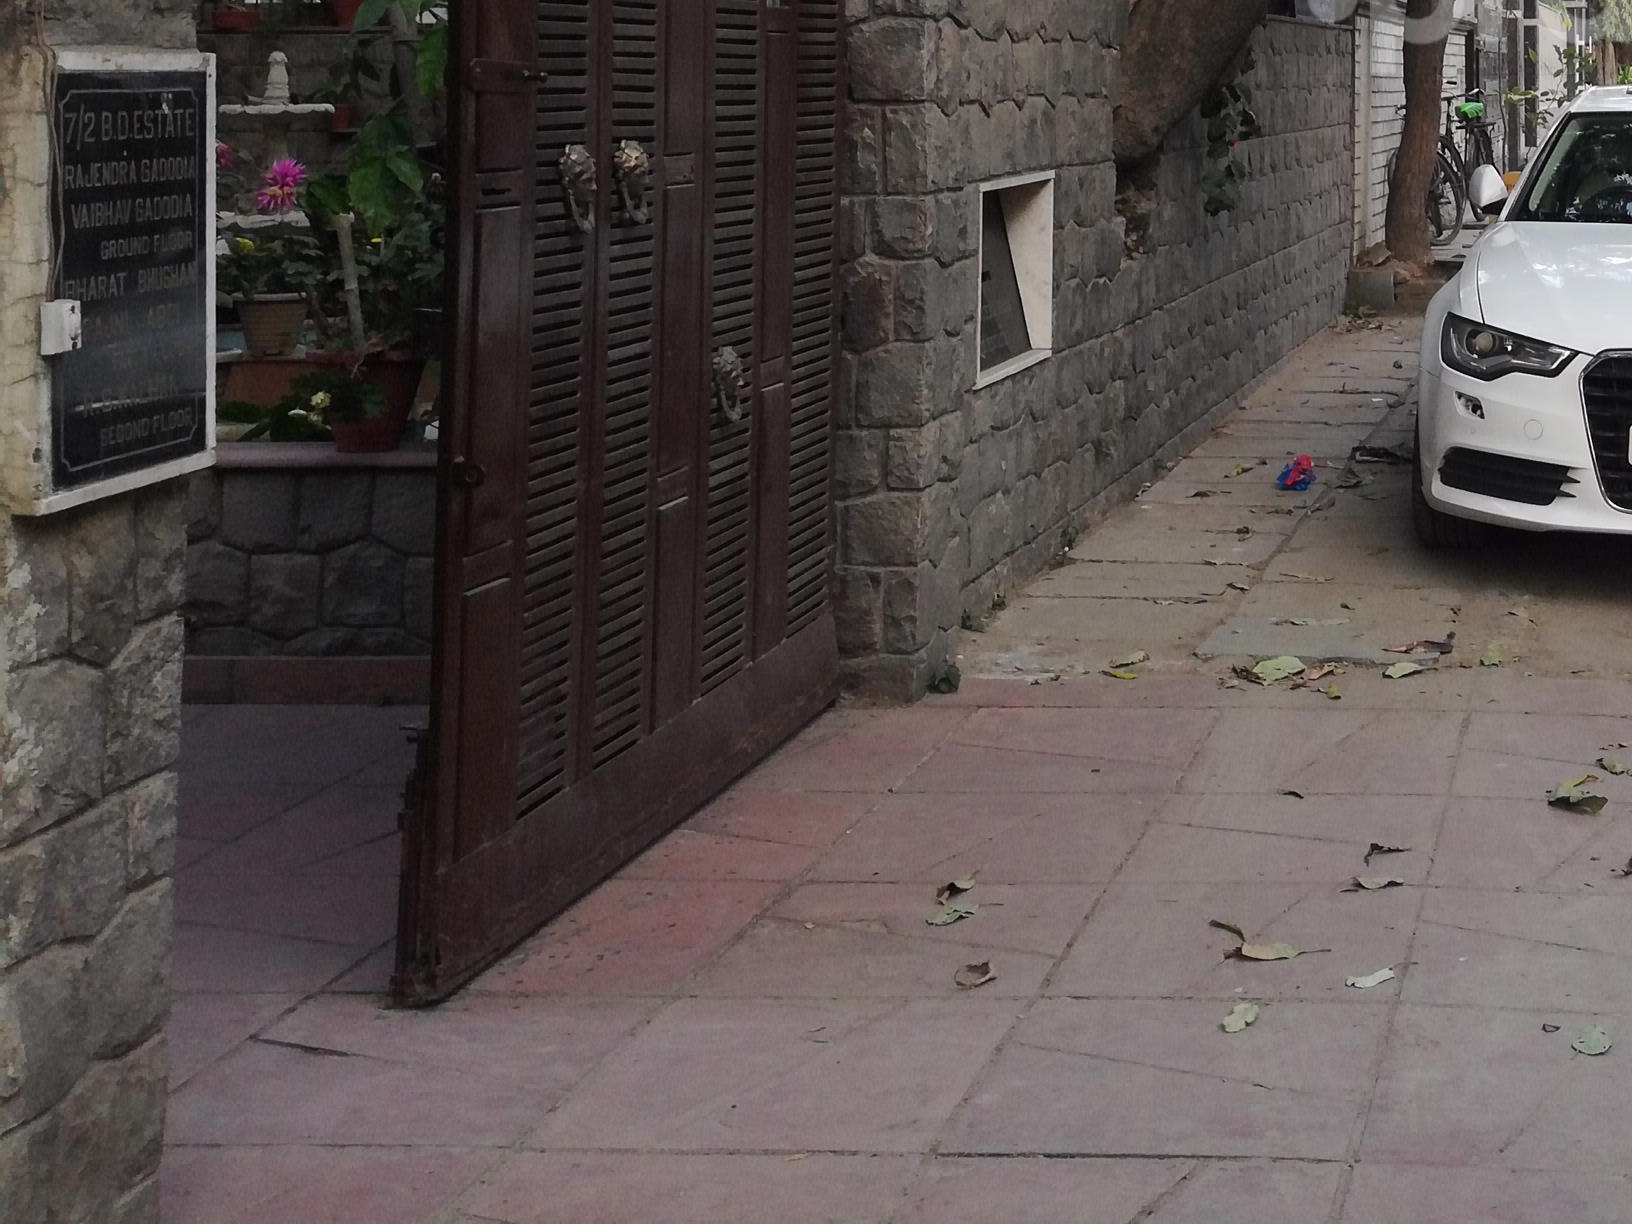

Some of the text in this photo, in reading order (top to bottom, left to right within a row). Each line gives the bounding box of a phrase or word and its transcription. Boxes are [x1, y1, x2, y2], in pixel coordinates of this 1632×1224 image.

[64, 103, 96, 151] 7/2
[65, 160, 138, 190] RAJENDRA
[71, 193, 193, 230] VAIBHAV GADODIA
[100, 230, 193, 261] GROUND FLOOR
[152, 407, 192, 435] FLOOR
